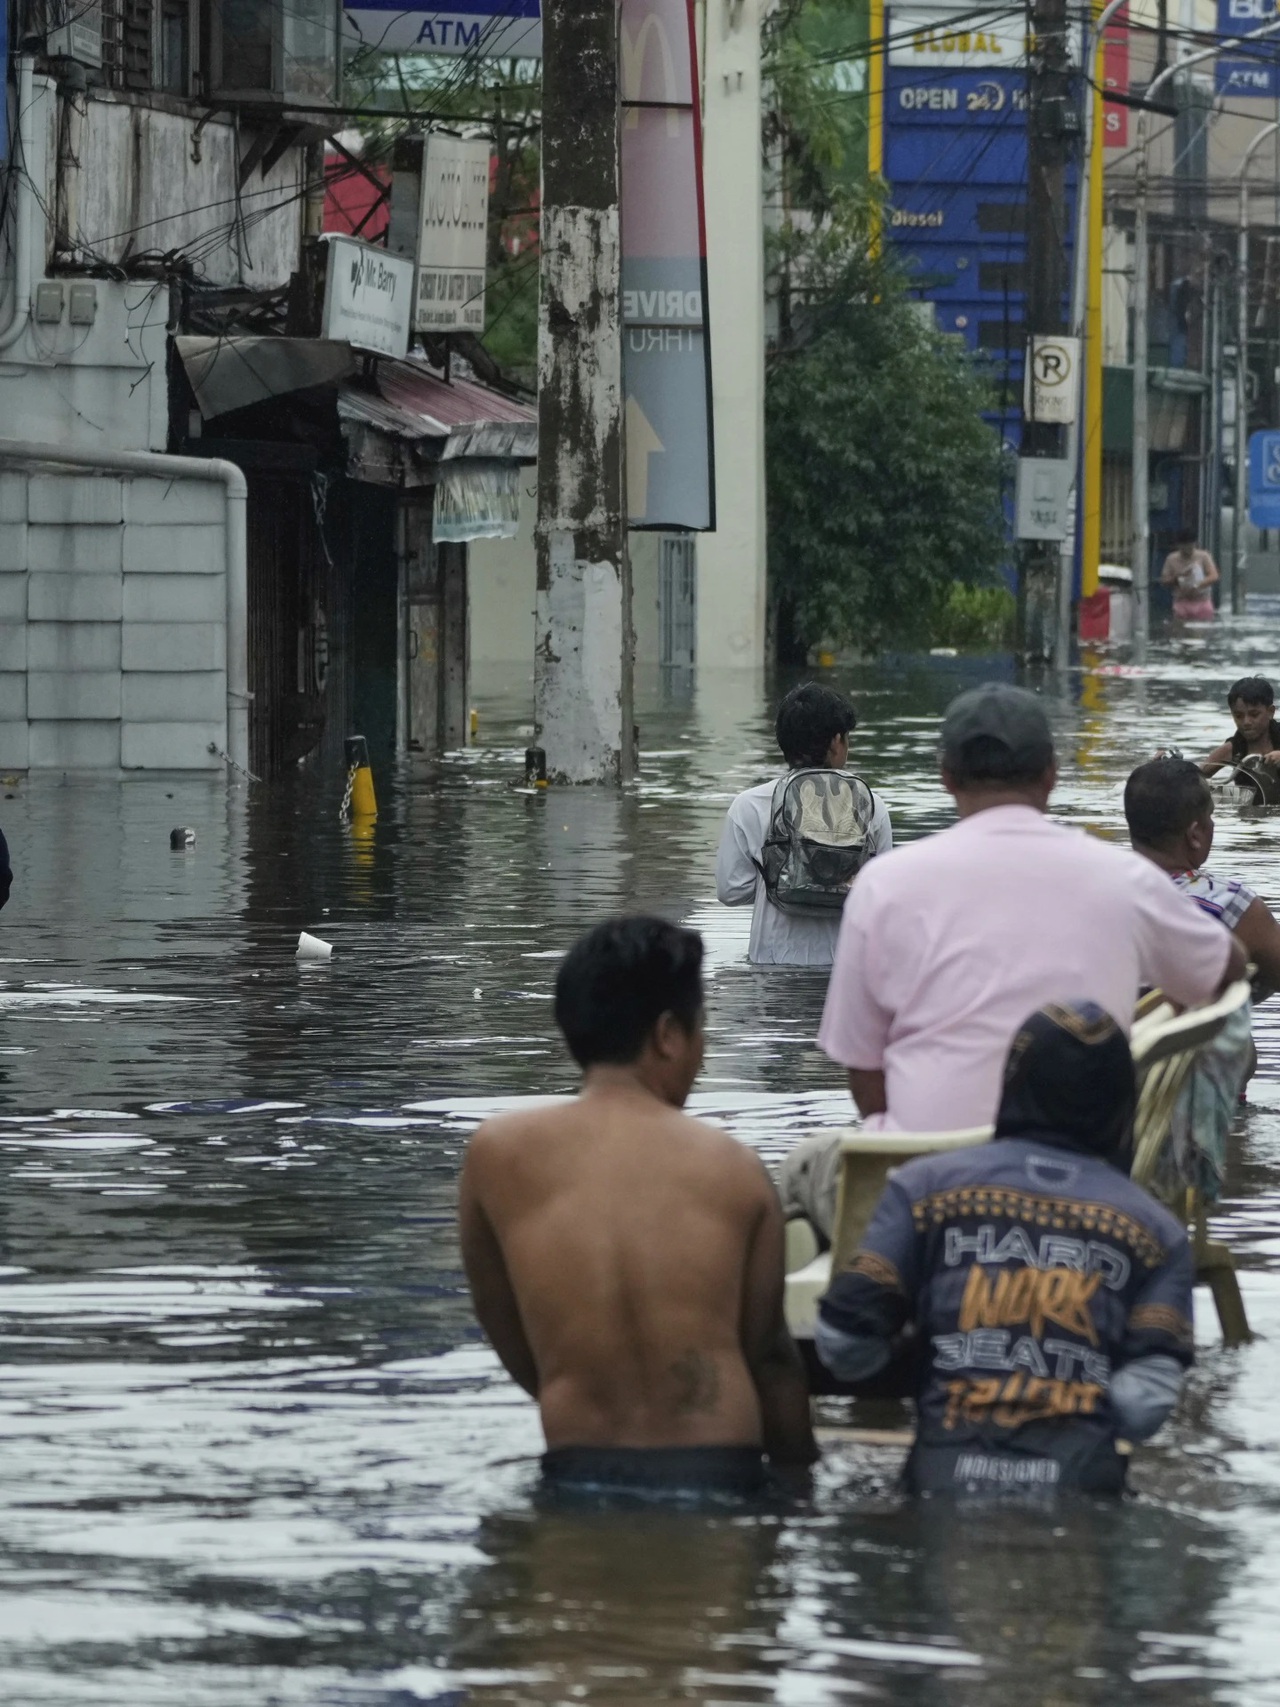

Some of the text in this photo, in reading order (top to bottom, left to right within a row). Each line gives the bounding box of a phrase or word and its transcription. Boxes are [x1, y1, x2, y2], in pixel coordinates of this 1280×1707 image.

[415, 20, 481, 48] ATM
[899, 88, 958, 110] OPEN
[1228, 71, 1270, 88] ATM
[366, 258, 376, 289] Mr.
[377, 261, 397, 303] Barry
[944, 1224, 1131, 1291] HARD
[957, 1263, 1100, 1348] WORK
[930, 1327, 1111, 1389] BEATS
